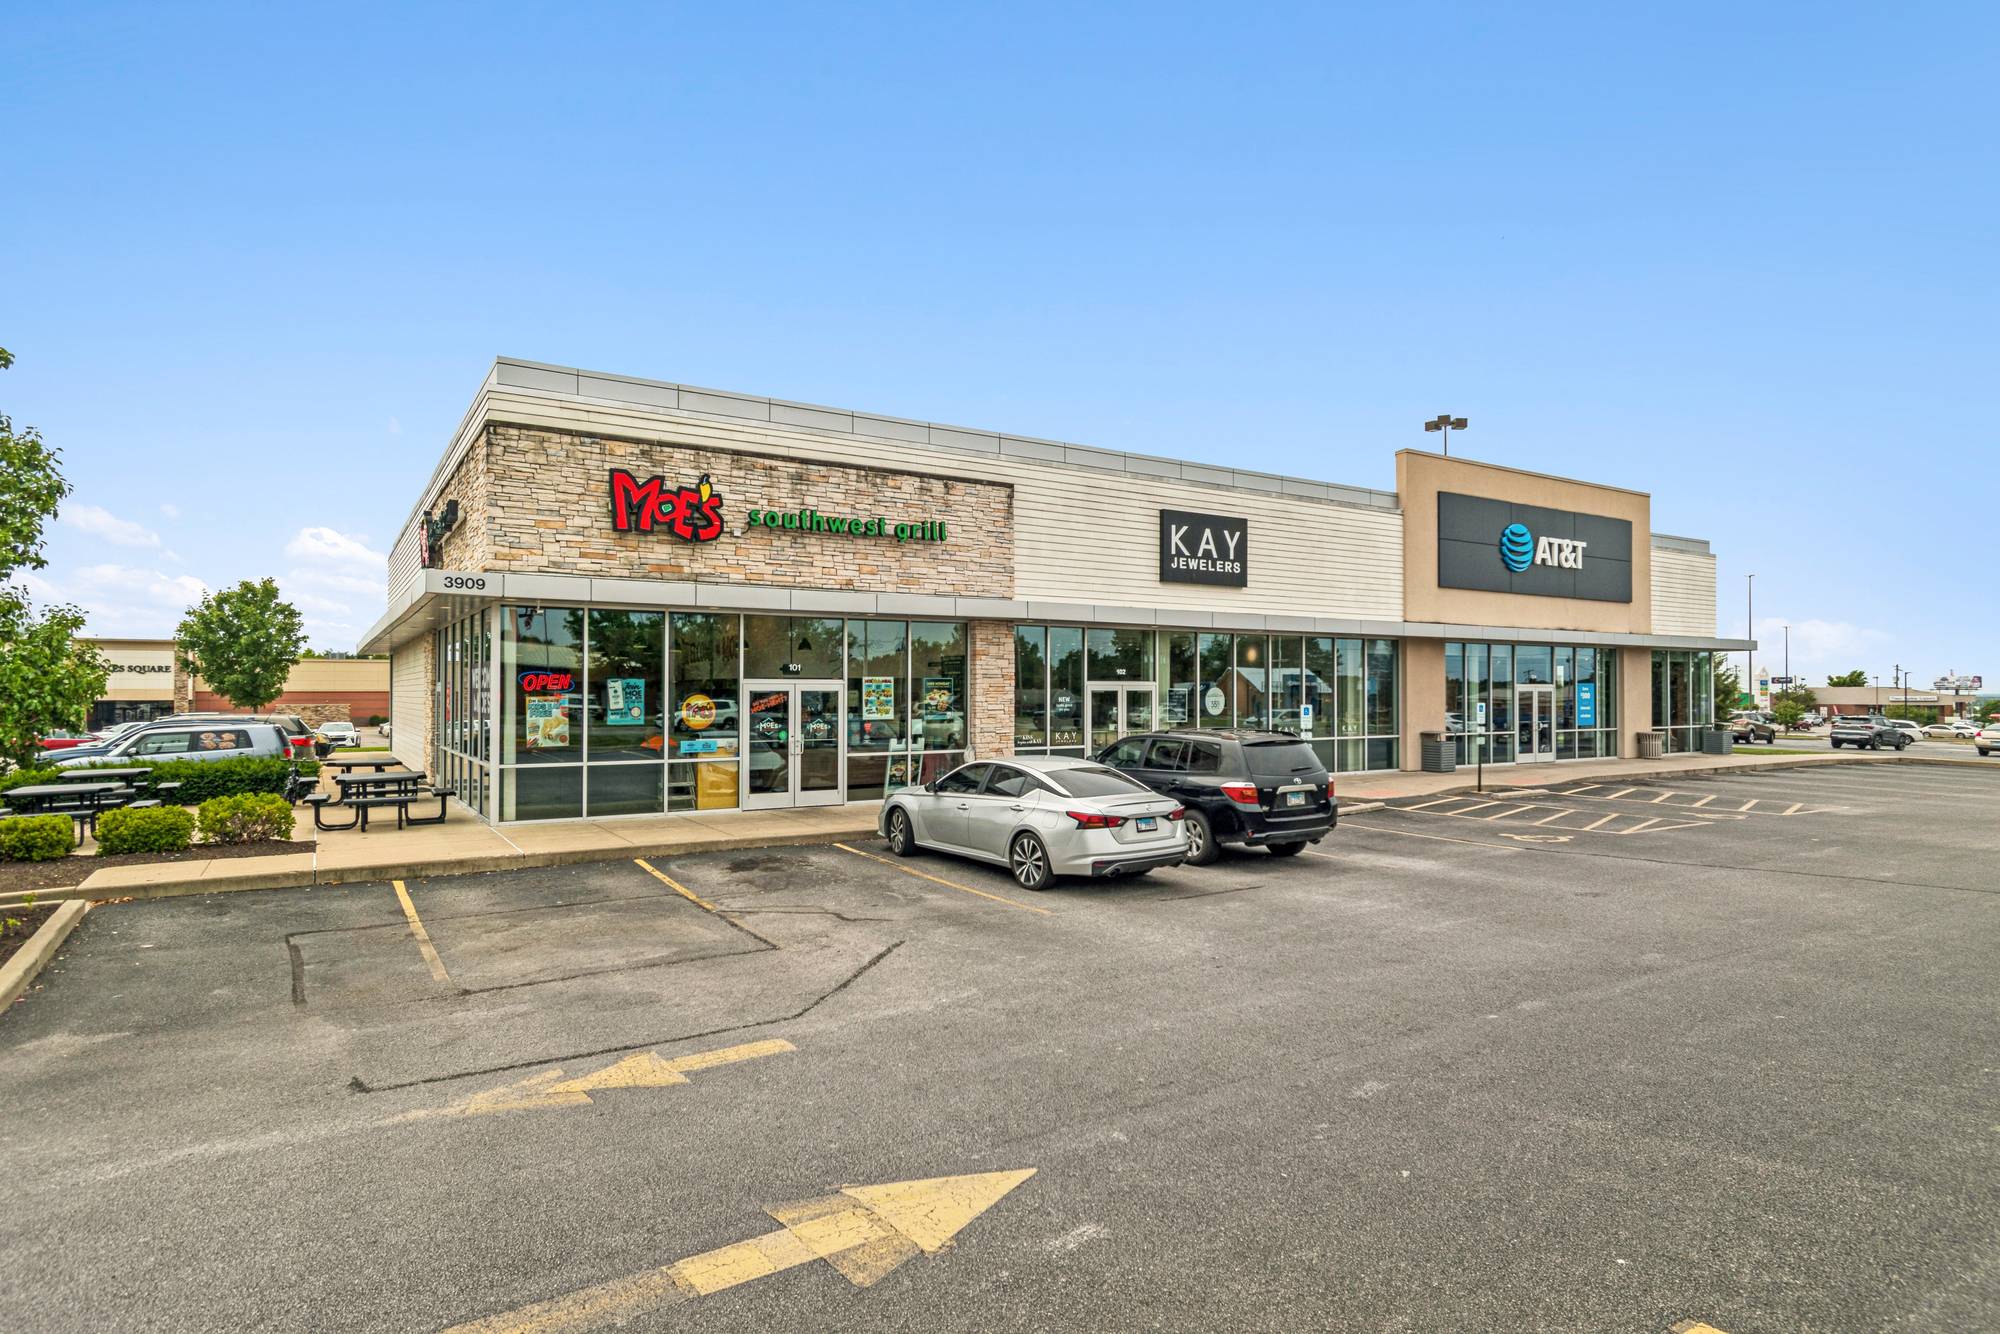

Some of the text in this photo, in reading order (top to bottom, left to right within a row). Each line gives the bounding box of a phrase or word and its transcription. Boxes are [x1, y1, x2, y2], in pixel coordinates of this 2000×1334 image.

[748, 509, 886, 537] southwest
[895, 520, 947, 542] grill
[1171, 524, 1240, 560] KAY
[1534, 536, 1587, 570] AT&T
[1171, 556, 1241, 574] JEWELERS
[443, 576, 486, 590] 3909
[127, 665, 172, 675] SQUARE
[789, 663, 801, 672] 101
[523, 673, 571, 691] OPEN
[1055, 731, 1077, 740] KAY
